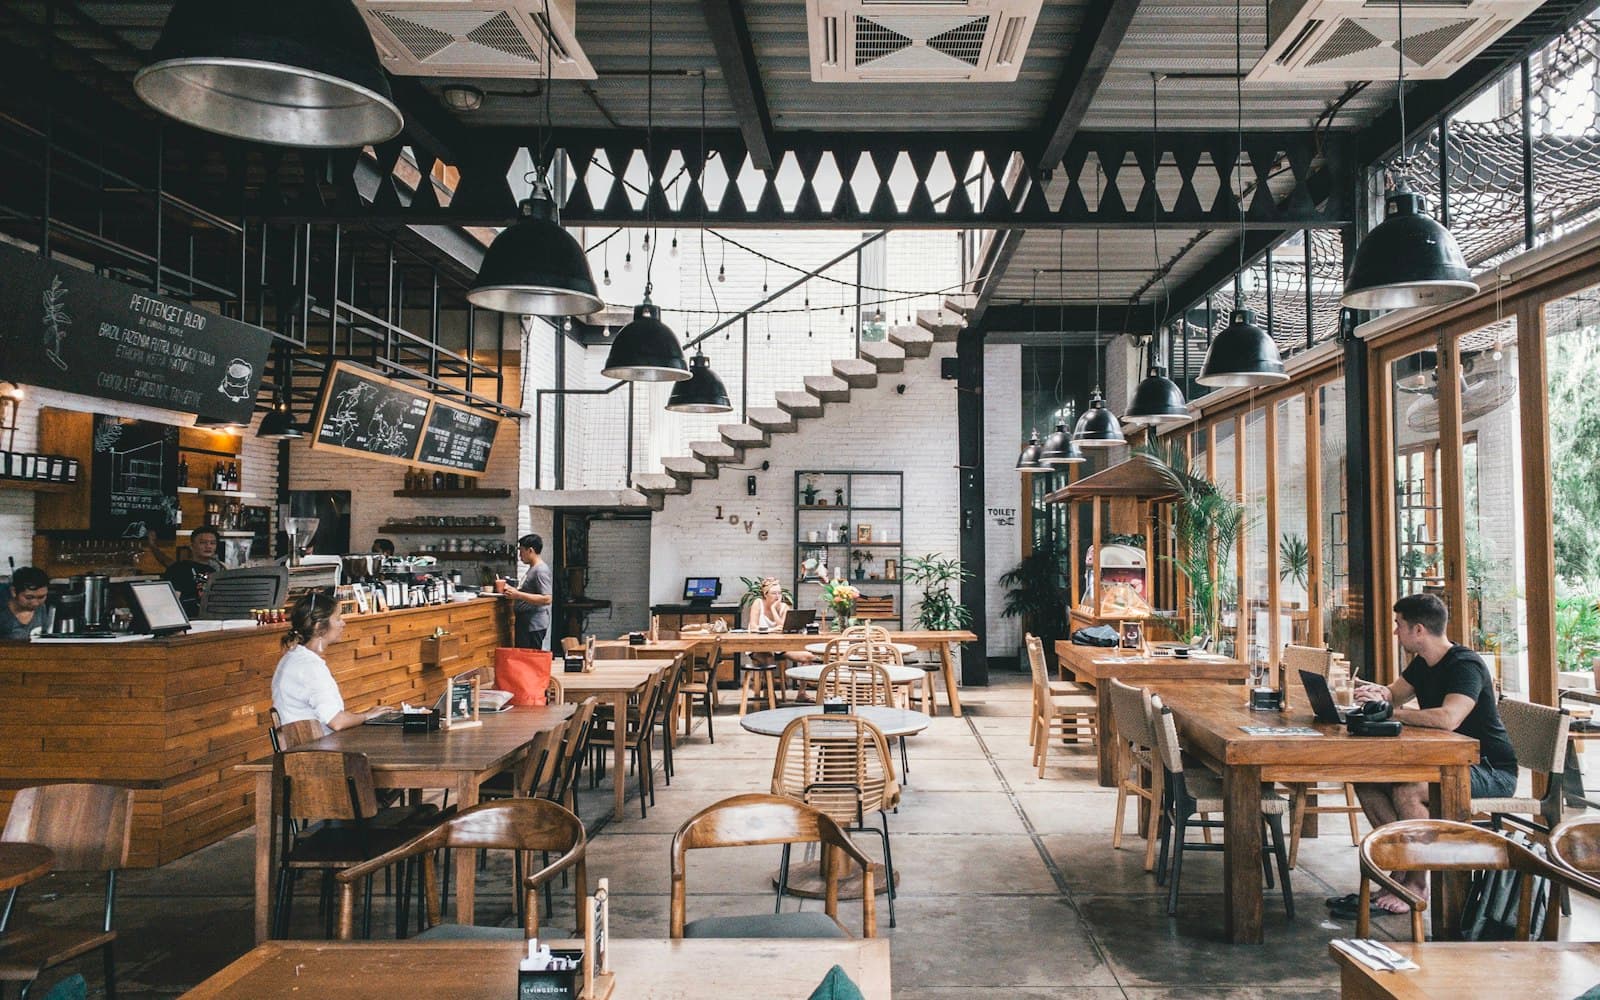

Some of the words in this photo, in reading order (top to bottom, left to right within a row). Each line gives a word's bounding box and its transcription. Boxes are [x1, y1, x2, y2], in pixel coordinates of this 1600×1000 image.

[129, 294, 184, 323] PETITENGET
[184, 311, 207, 330] BLEND
[714, 505, 769, 541] love
[987, 508, 1017, 516] TOILET
